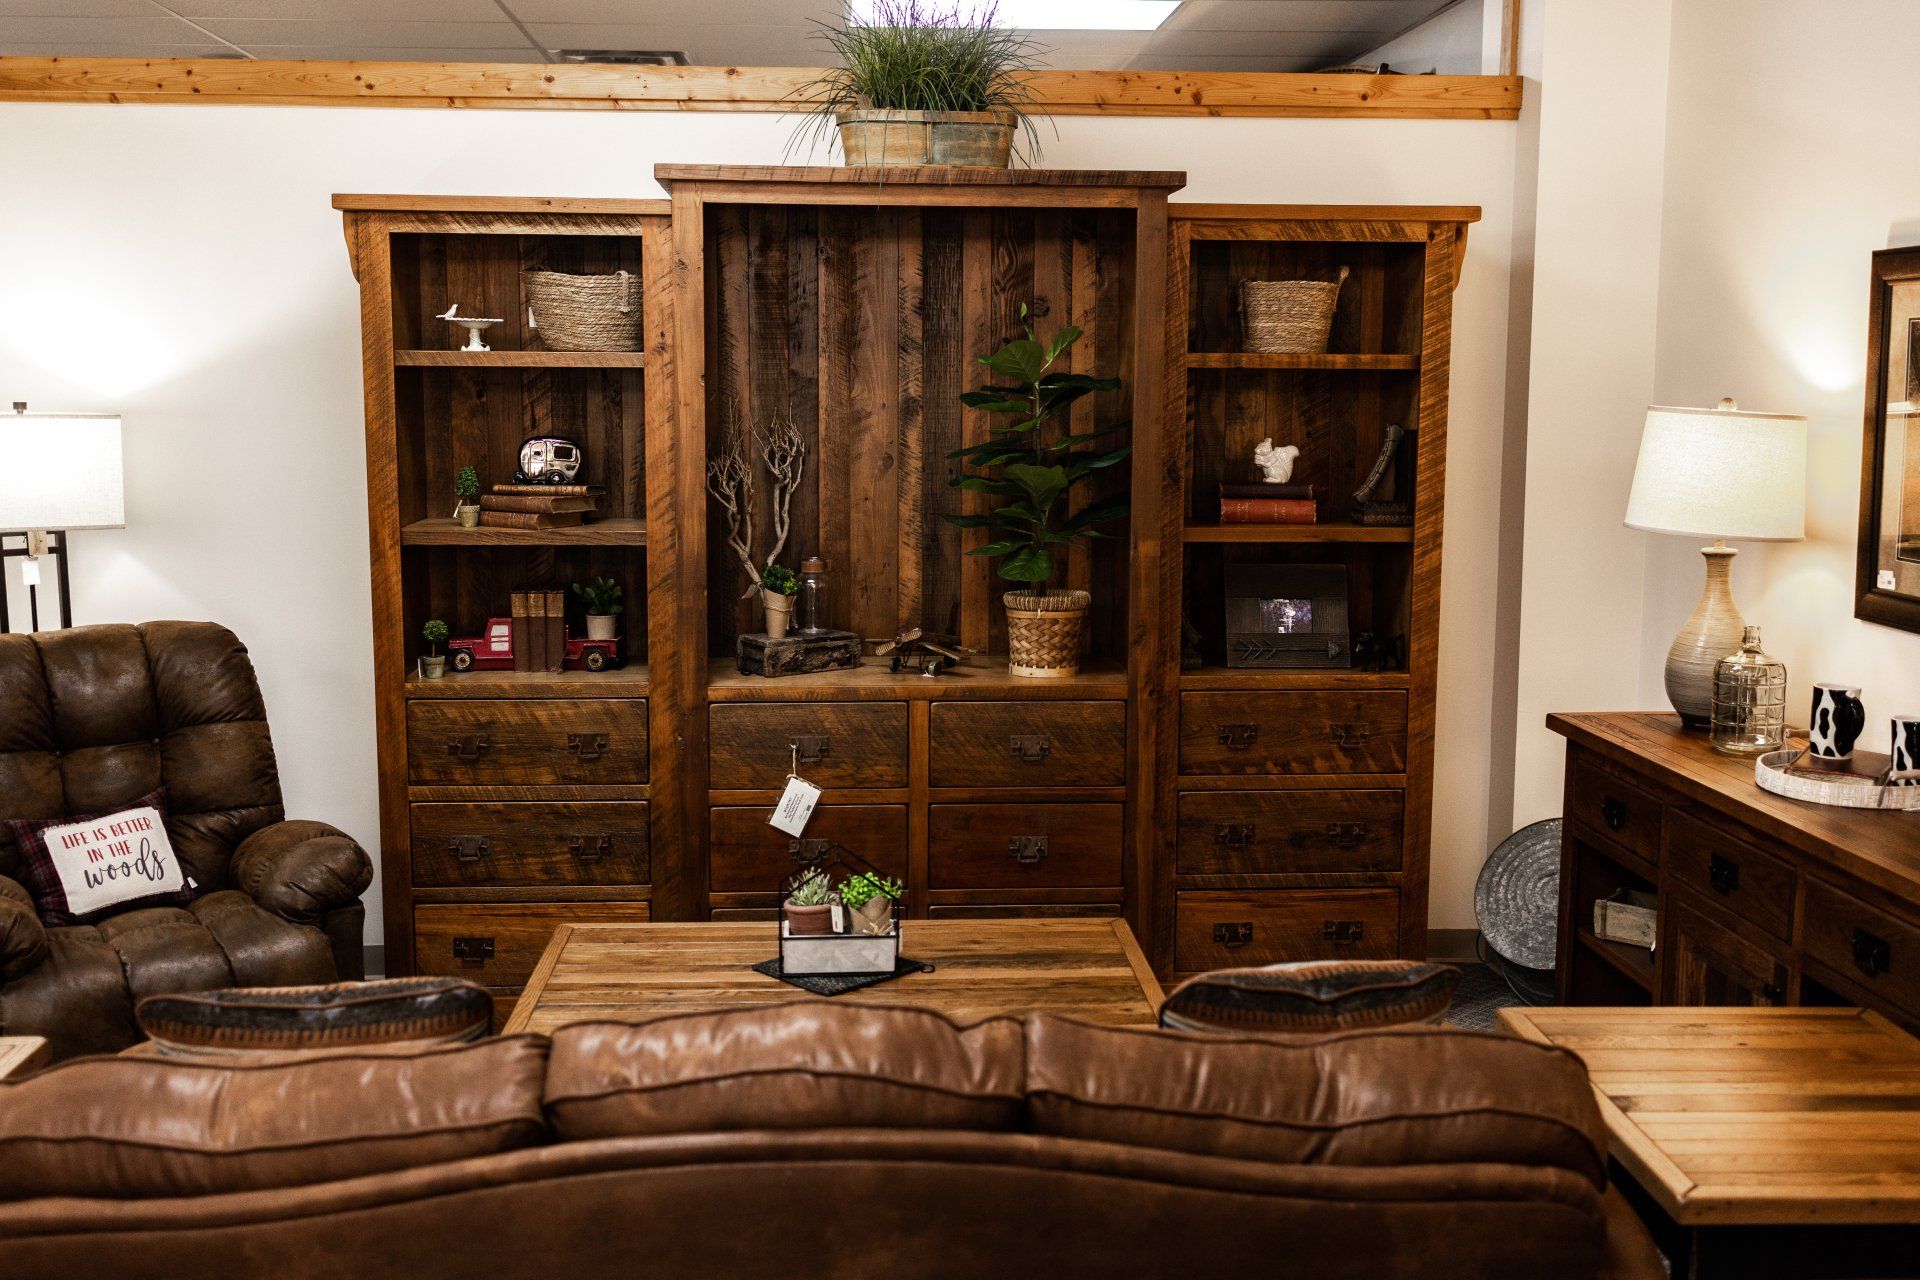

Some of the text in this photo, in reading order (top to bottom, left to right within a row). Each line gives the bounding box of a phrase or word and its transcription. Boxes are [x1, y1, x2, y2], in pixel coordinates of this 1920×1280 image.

[61, 817, 153, 849] LIFE IS BETTER
[84, 837, 166, 888] woods
[87, 840, 132, 863] IN THE
